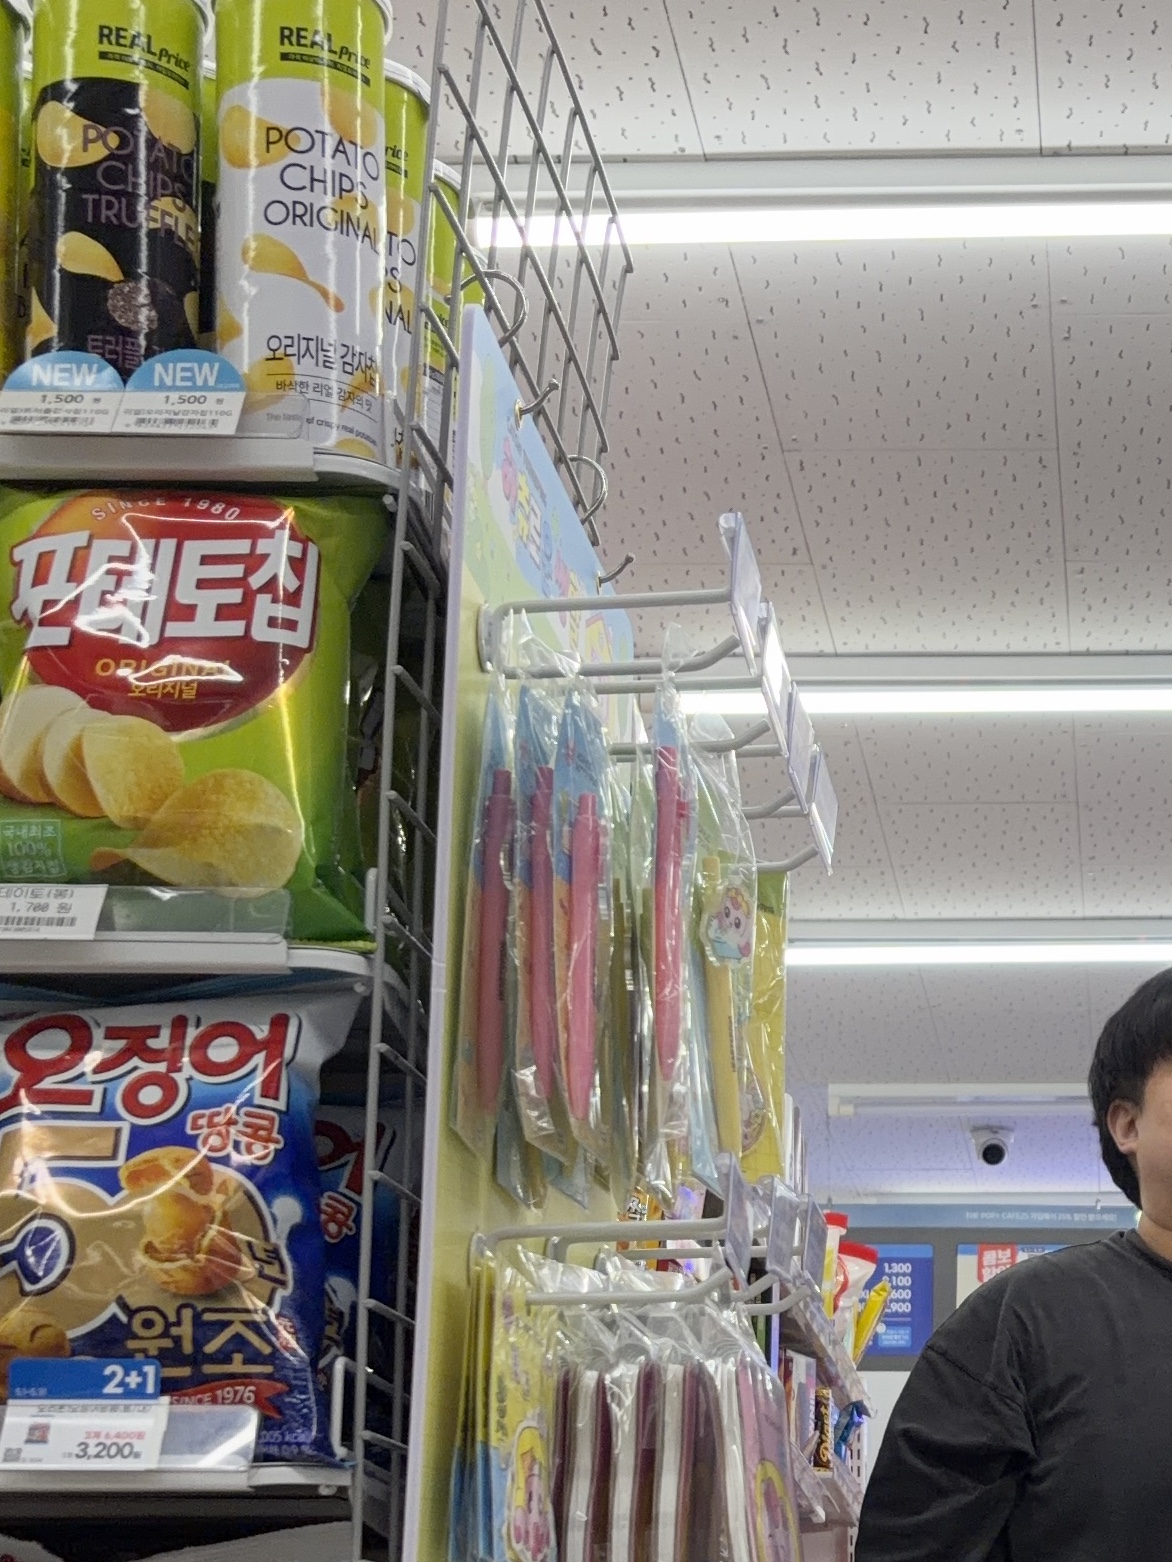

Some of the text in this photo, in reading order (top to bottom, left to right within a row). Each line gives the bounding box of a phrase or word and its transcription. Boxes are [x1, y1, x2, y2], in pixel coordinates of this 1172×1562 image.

[98, 25, 156, 57] REAL
[279, 26, 341, 55] REAL
[265, 126, 380, 182] POTATO
[279, 162, 369, 210] CHIPS
[263, 199, 380, 256] ORIGINAL
[265, 333, 337, 370] 오리지널
[31, 362, 99, 387] NEW
[153, 361, 221, 387] NEW
[275, 379, 310, 394] 바삭한
[40, 393, 85, 405] 1,500
[163, 394, 208, 406] 1,500
[183, 496, 240, 520] 1980
[0, 1012, 296, 1120] 오징어
[188, 1105, 284, 1164] 땅콩
[883, 1261, 912, 1275] 1,300
[124, 1306, 275, 1377] 원조
[102, 1364, 156, 1395] 2+1
[215, 1385, 257, 1404] 1976
